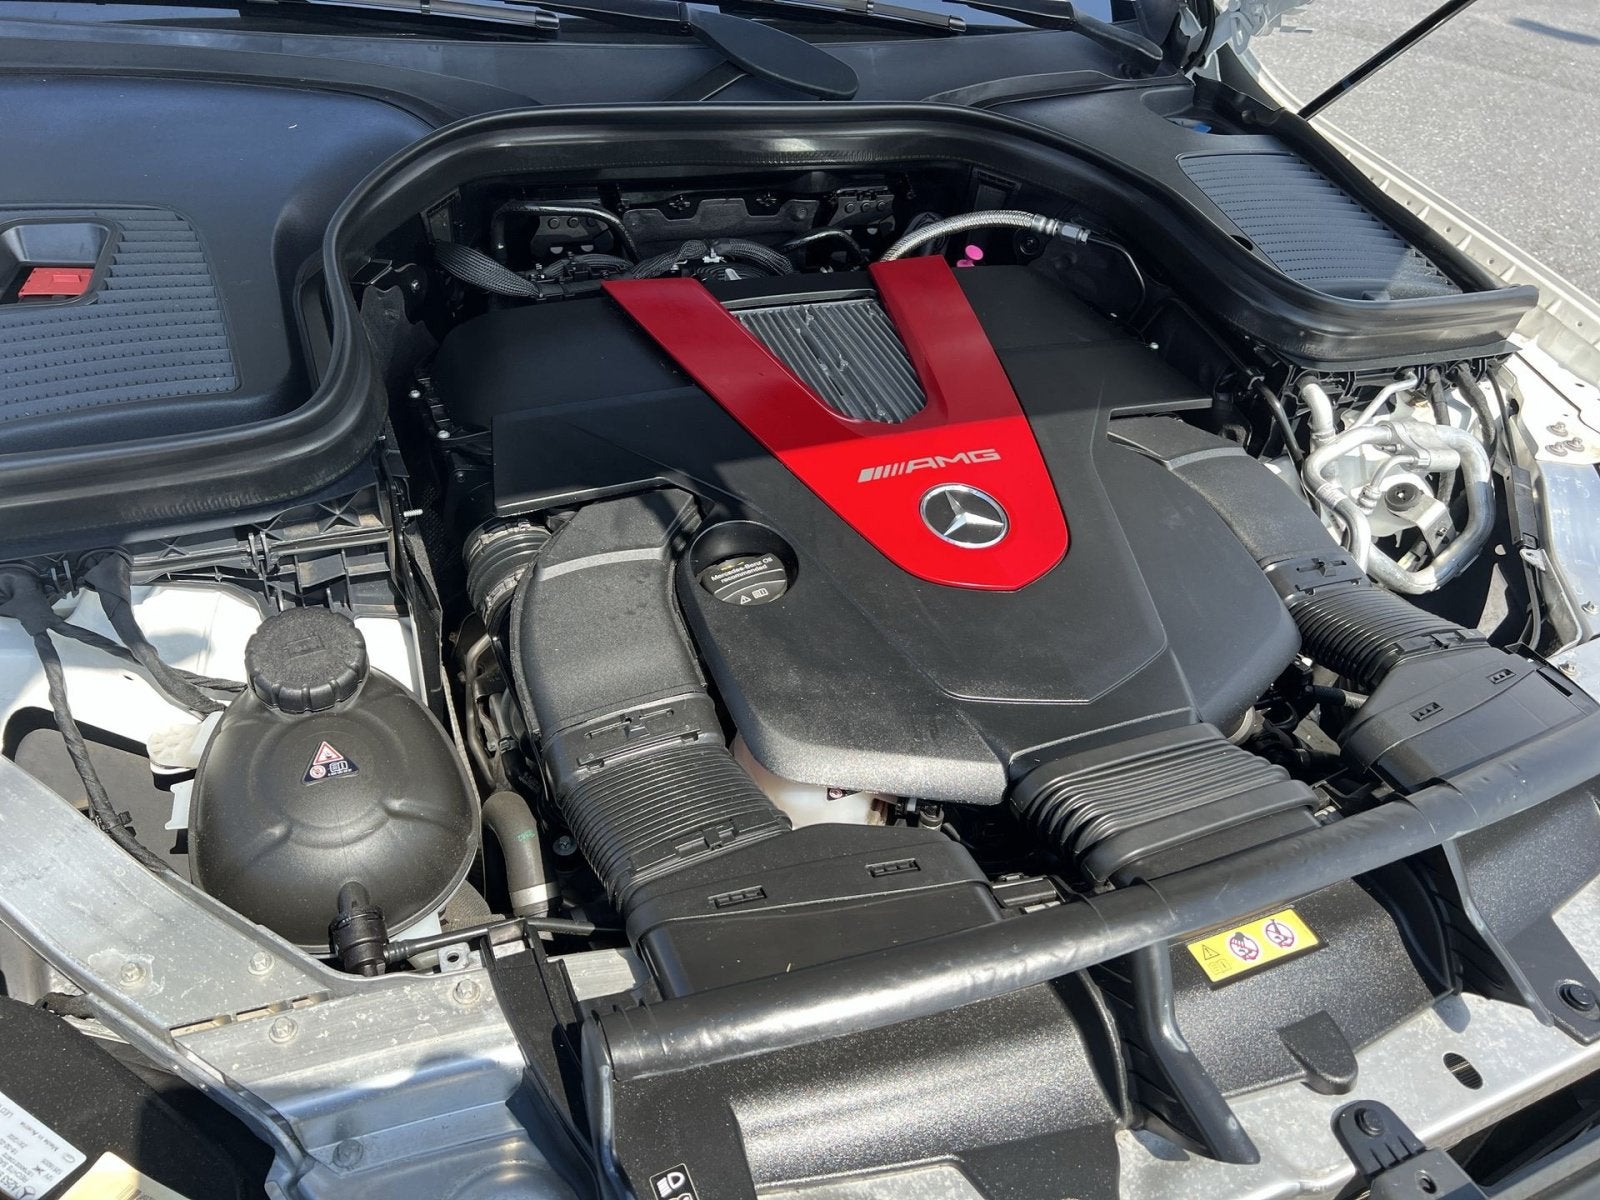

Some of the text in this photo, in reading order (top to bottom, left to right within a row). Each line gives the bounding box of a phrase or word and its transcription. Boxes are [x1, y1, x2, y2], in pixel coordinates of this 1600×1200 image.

[905, 448, 1001, 474] AMG
[711, 560, 763, 581] Mercedes-Benz
[720, 564, 768, 583] recommended
